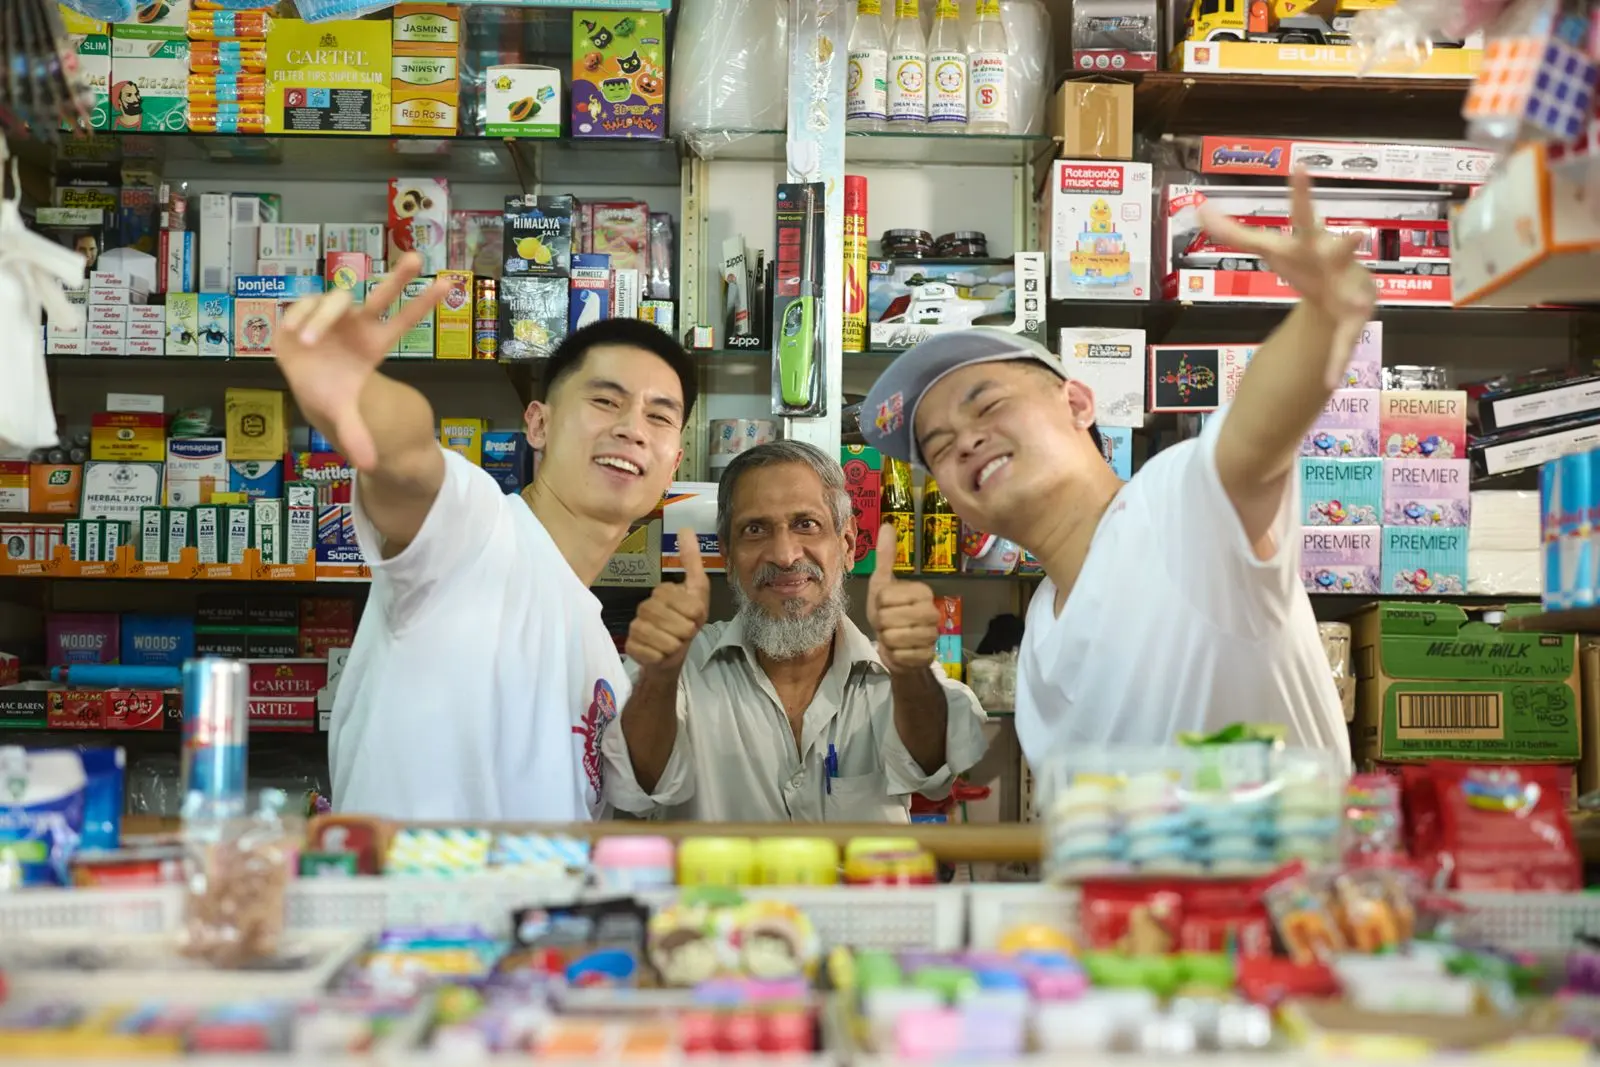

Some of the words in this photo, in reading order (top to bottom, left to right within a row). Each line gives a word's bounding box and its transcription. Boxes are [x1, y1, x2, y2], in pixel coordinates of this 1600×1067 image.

[403, 24, 448, 33] JASMINE
[84, 41, 106, 50] SLIM
[164, 45, 186, 54] SLIM
[286, 50, 369, 66] CARTEL
[402, 64, 445, 74] JASMINE
[274, 70, 304, 81] FILTER
[307, 70, 326, 82] TIPS
[330, 71, 357, 82] SUPER
[360, 71, 382, 84] SLIM
[402, 109, 420, 118] RED
[422, 110, 446, 119] ROSE
[1065, 178, 1094, 187] music
[1096, 178, 1120, 188] cake
[514, 218, 560, 229] HIMALAYA
[576, 270, 603, 278] AMMELTZ
[238, 278, 285, 292] bonjela
[1388, 279, 1432, 290] TRAIN
[618, 274, 628, 318] ounterpain
[728, 336, 760, 347] zippo
[1322, 398, 1368, 413] EMIER
[1390, 399, 1456, 414] PREMIER
[172, 442, 220, 452] Hansaplast
[170, 462, 200, 470] ELASTIC
[303, 466, 356, 480] Skittles
[1306, 466, 1373, 481] PREMIER
[1392, 468, 1459, 484] PREMIER
[88, 494, 120, 502] HERBAL
[1304, 534, 1372, 549] PREMIER
[1390, 534, 1458, 550] PREMIER
[218, 608, 243, 616] BAREN
[269, 610, 295, 618] BAREN
[250, 646, 267, 654] MAC
[269, 646, 295, 654] BAREN
[1426, 642, 1485, 657] MELON
[1488, 644, 1531, 658] MILK
[252, 680, 315, 692] CARTEL
[0, 702, 16, 710] MAC
[18, 702, 44, 710] BAREN
[248, 703, 298, 715] ARTEL
[1528, 740, 1558, 748] bottles
